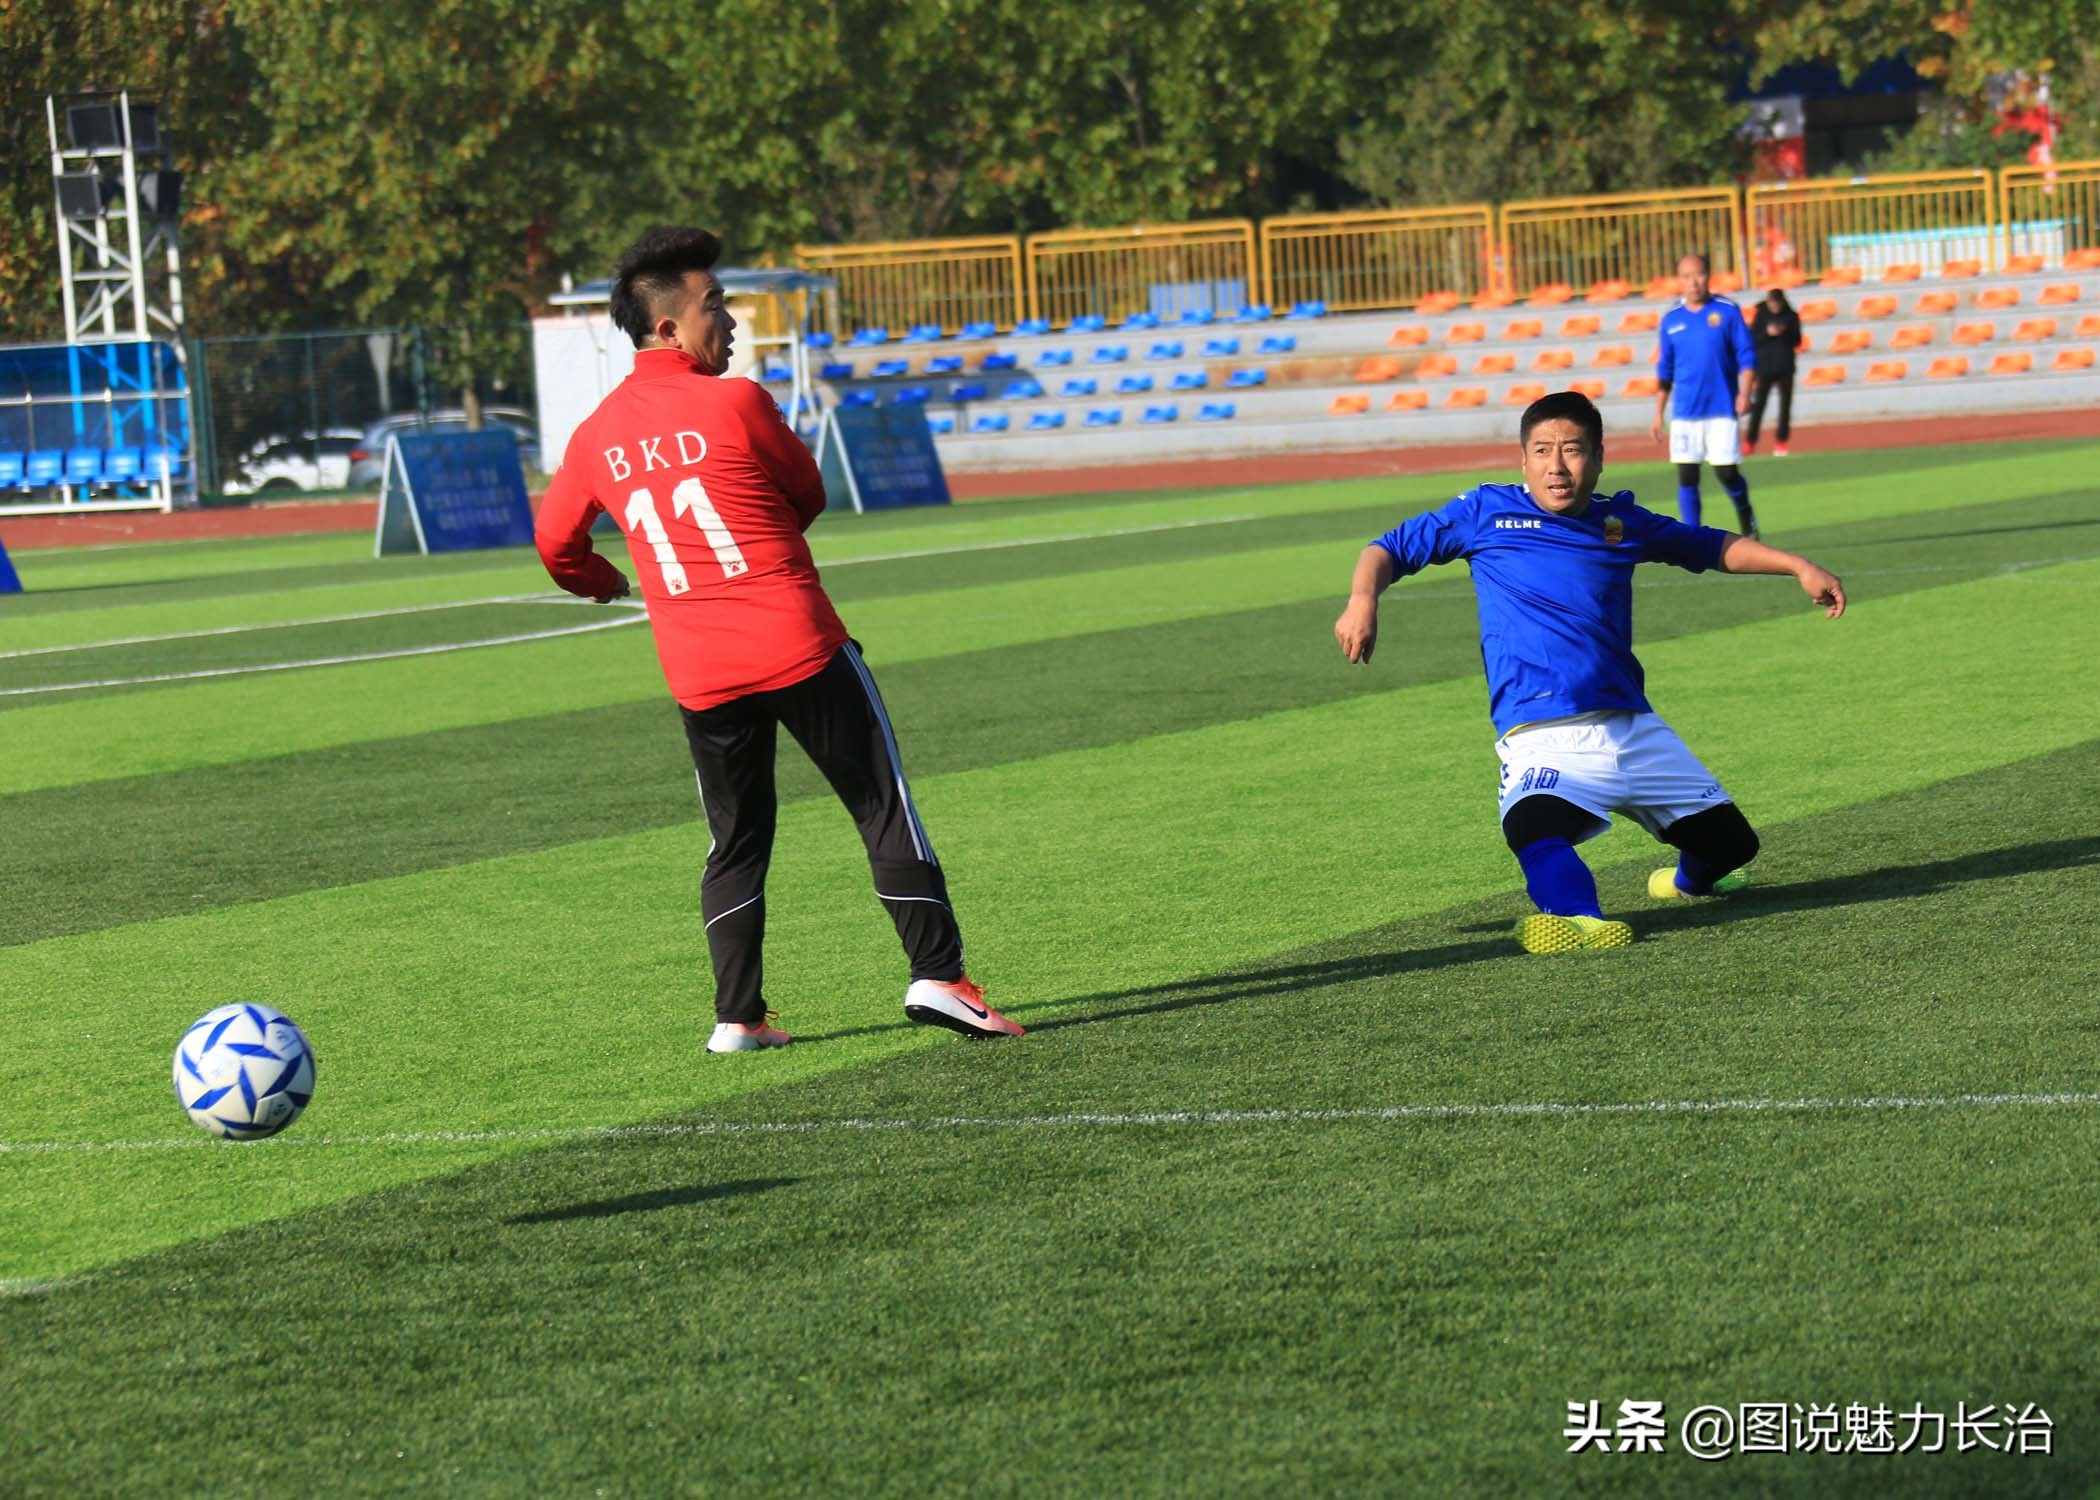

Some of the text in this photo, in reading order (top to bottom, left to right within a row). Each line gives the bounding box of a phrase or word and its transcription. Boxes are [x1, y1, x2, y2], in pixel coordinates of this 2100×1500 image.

[603, 430, 708, 483] BKD
[624, 477, 749, 596] 11
[1495, 519, 1542, 529] KELME
[1520, 766, 1560, 791] 10
